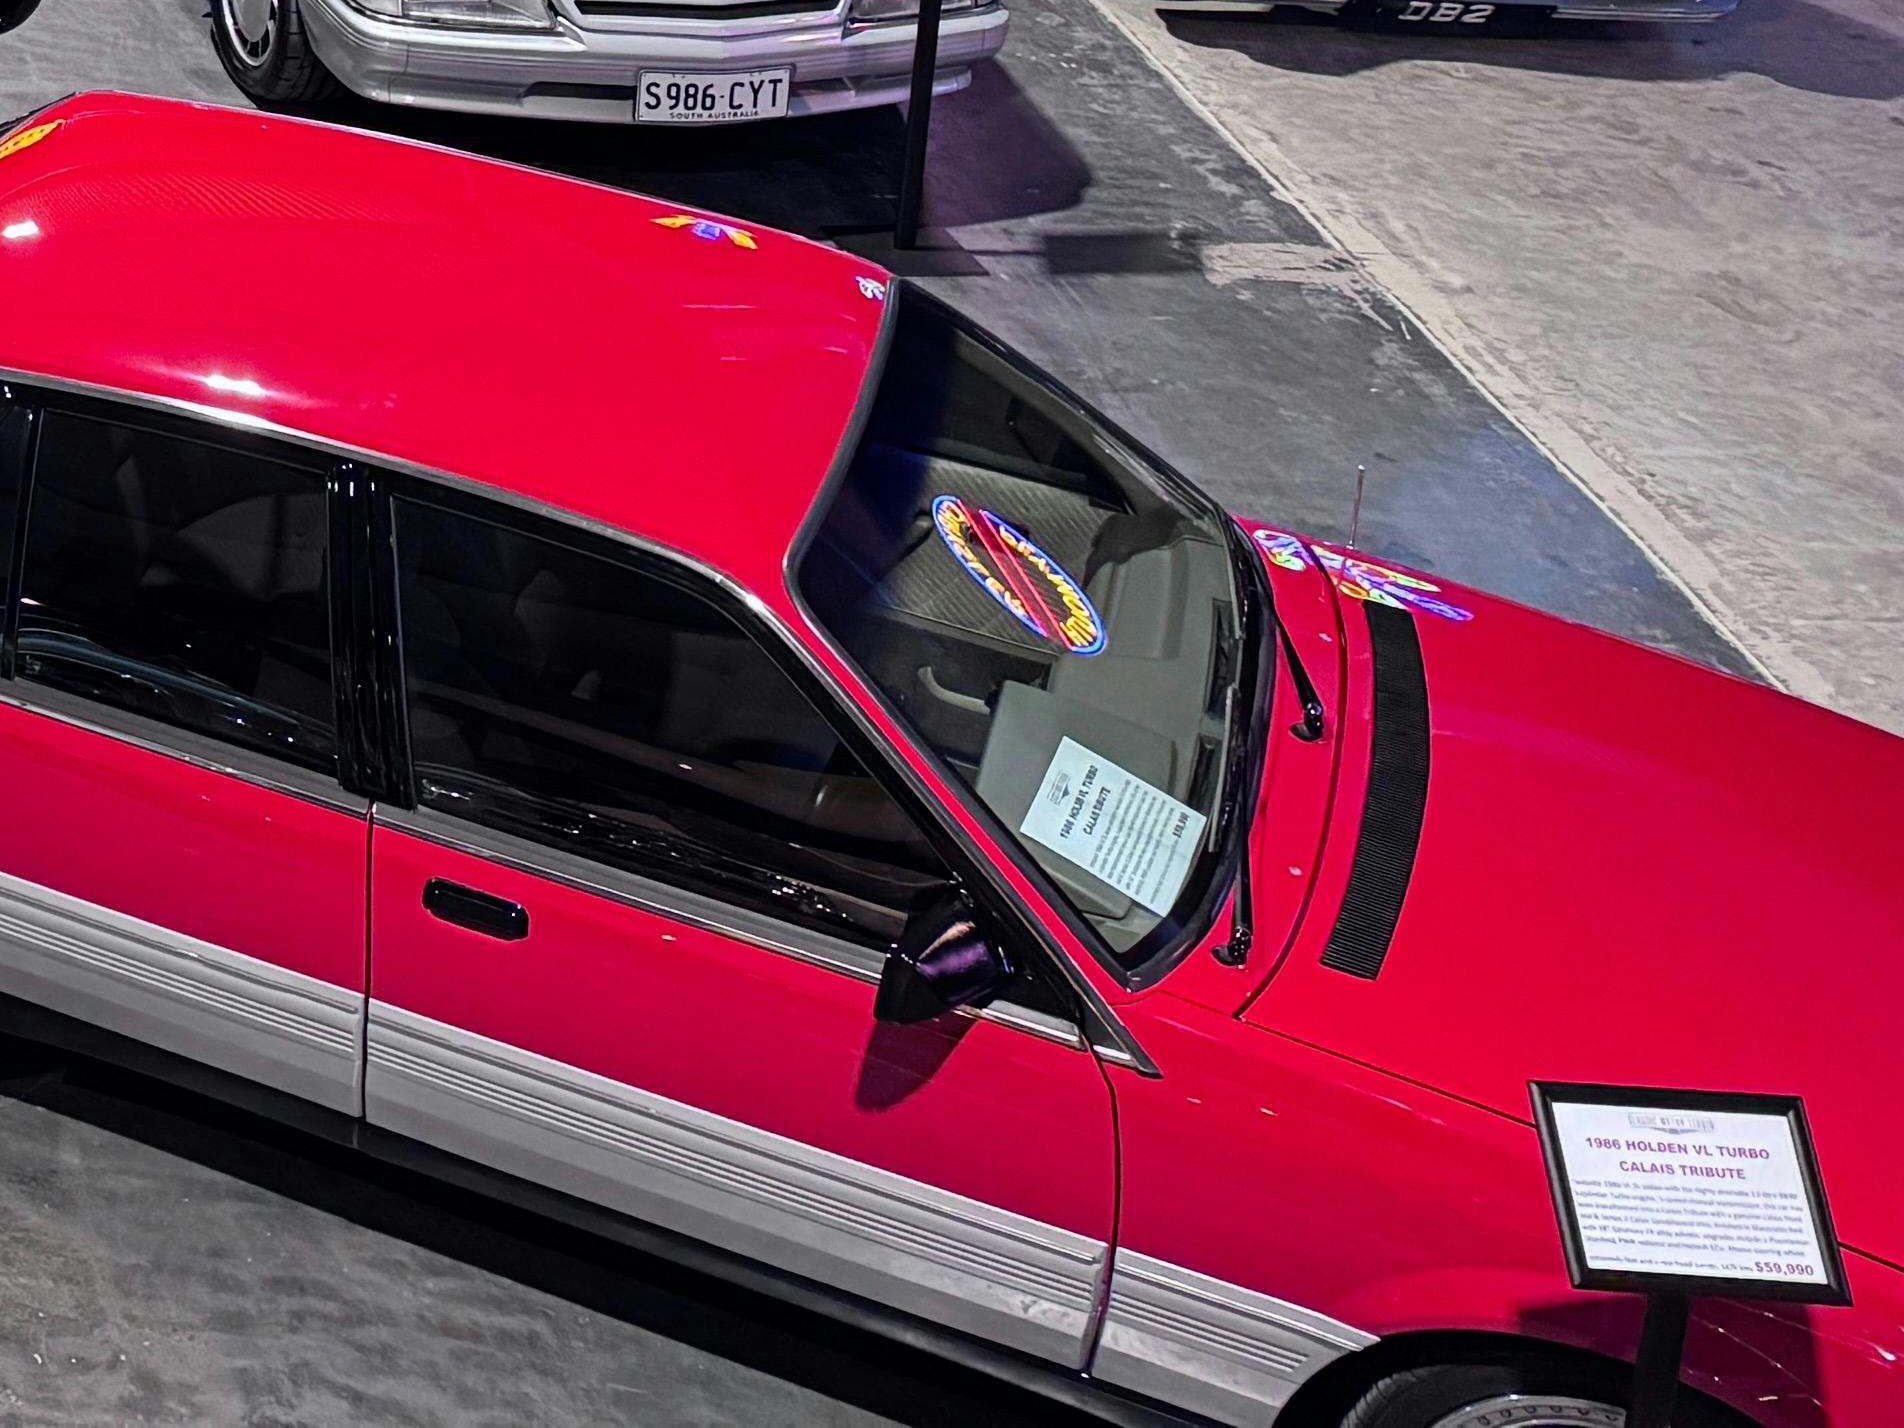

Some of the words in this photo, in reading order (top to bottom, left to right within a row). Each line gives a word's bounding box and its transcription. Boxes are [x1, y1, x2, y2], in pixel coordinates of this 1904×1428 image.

[1397, 0, 1497, 24] DB2
[645, 78, 783, 112] S986-CYT
[1585, 1136, 1622, 1151] 1986
[1625, 1139, 1689, 1156] HOLDEN
[1692, 1144, 1713, 1157] VL
[1716, 1145, 1771, 1160] TURBO
[1619, 1160, 1676, 1176] CALAIS
[1679, 1164, 1747, 1180] TRIBUTE
